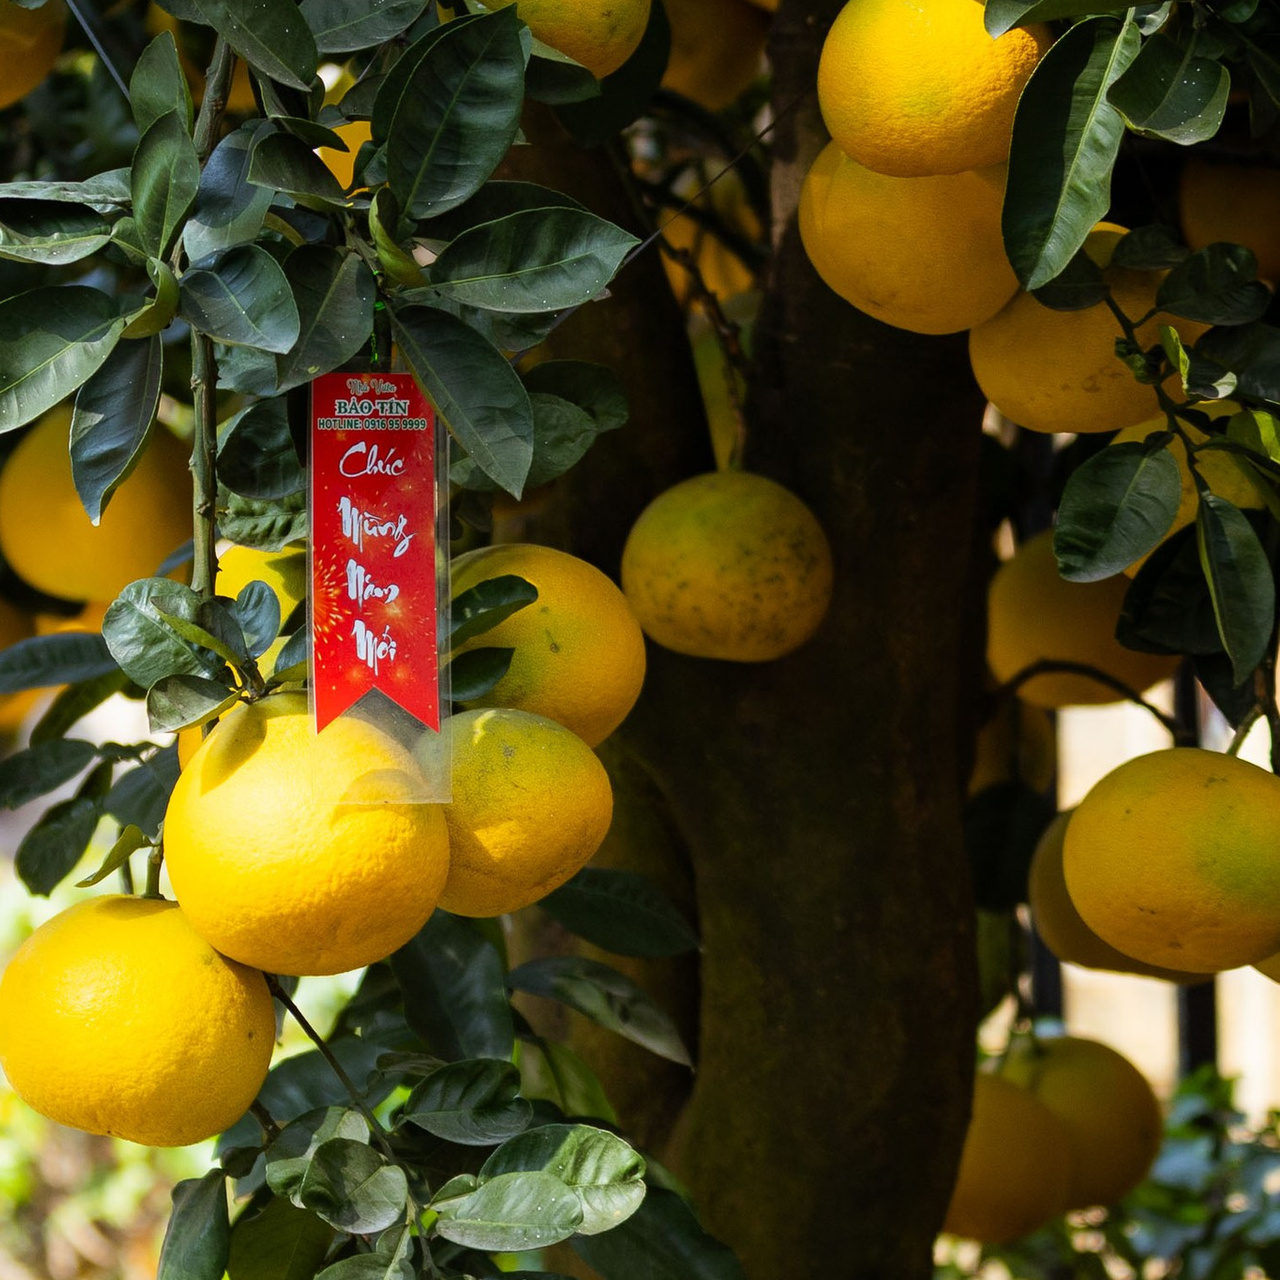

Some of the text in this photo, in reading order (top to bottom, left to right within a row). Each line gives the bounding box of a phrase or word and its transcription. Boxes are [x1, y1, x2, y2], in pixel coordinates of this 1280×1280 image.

[318, 418, 427, 430] HOTLINE: 0916 95 9999
[376, 397, 409, 416] TÍN
[339, 441, 407, 478] Chúc
[337, 496, 416, 558] Mừng
[351, 619, 397, 677] Mới
